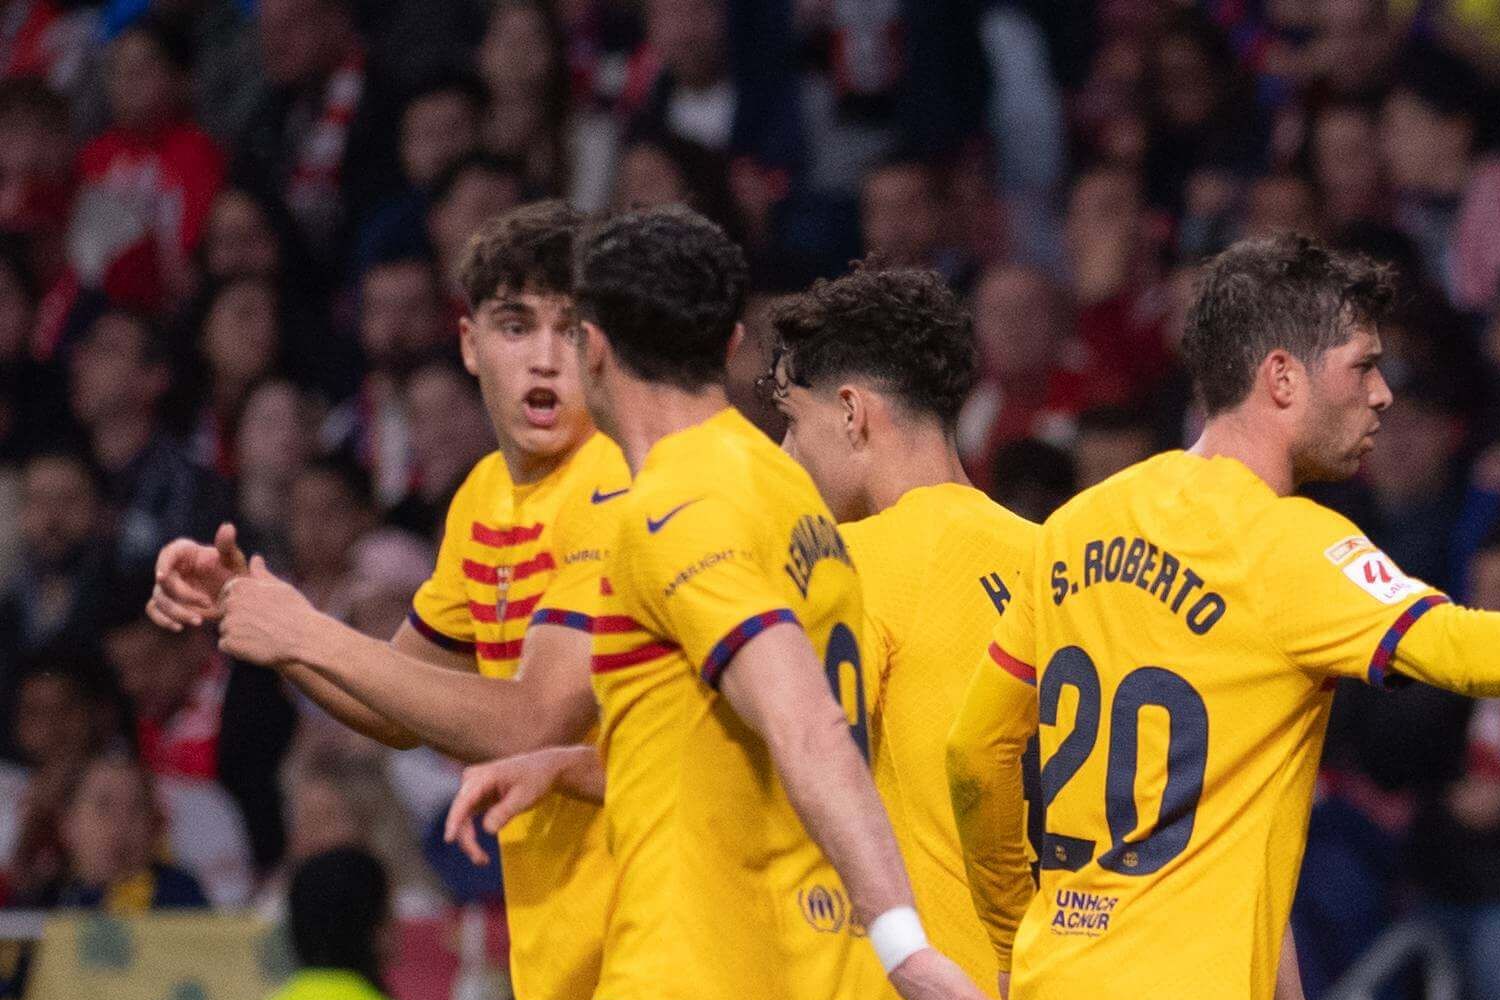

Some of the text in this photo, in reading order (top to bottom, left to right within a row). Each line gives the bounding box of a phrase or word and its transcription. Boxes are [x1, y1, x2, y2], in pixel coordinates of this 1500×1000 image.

[1051, 537, 1226, 636] S. ROBERTO
[1039, 645, 1209, 877] 20
[1052, 909, 1110, 930] ACNUR
[1056, 889, 1119, 911] UNHCR
